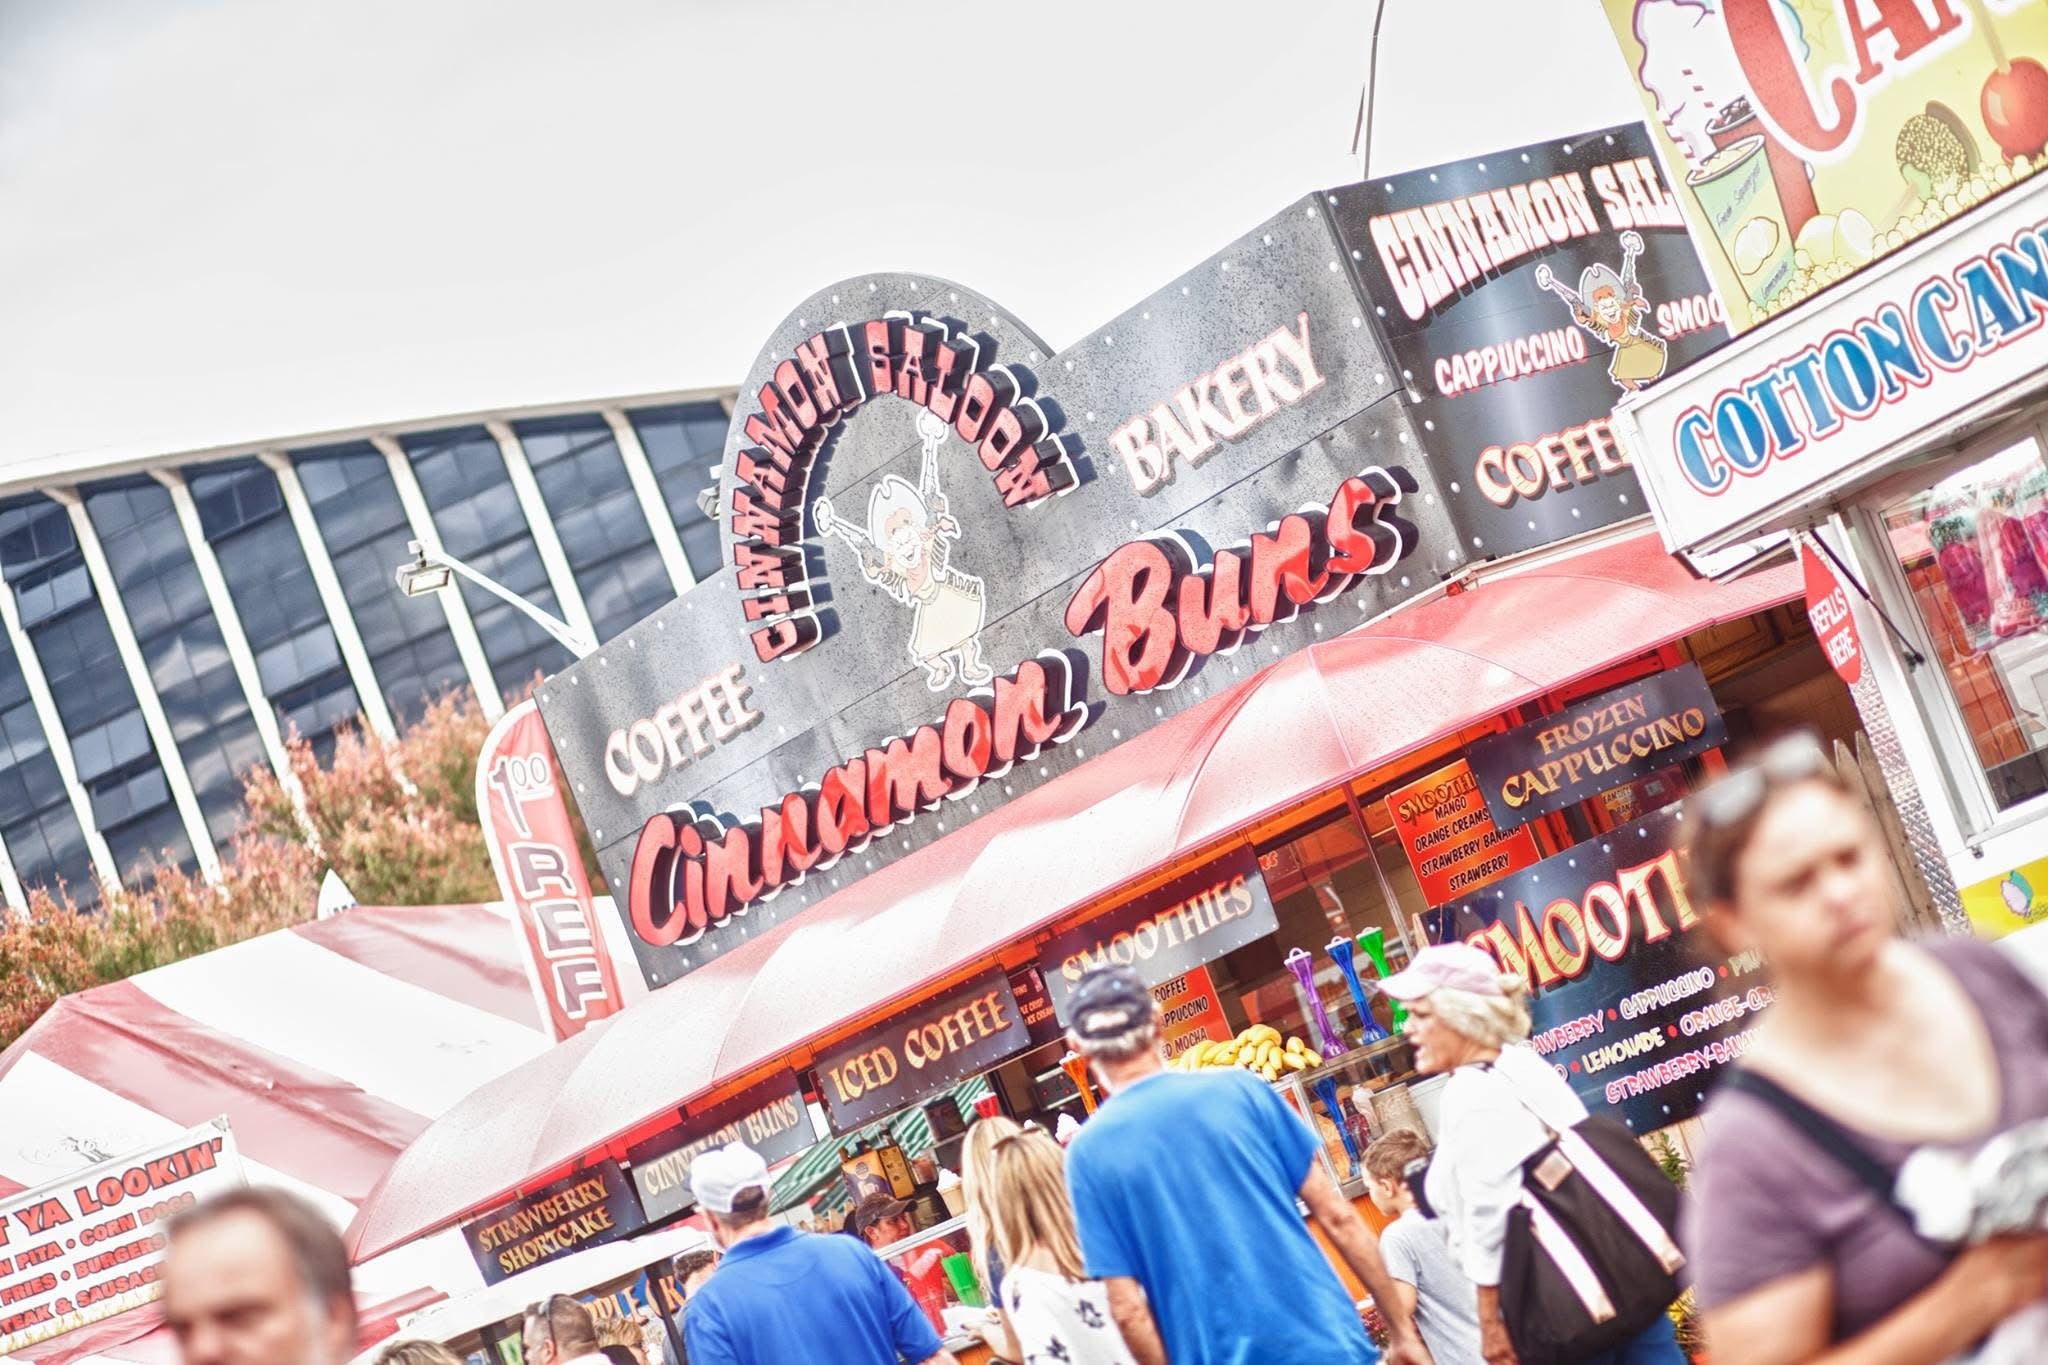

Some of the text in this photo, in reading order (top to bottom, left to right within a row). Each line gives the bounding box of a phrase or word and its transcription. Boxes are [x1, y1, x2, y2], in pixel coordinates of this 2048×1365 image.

[1722, 0, 1962, 152] CA
[1368, 171, 1602, 321] CINNAMON
[1434, 325, 1588, 397] CAPPUCCINO
[1677, 225, 2048, 492] COTTON CAN
[1106, 309, 1327, 494] BAKERY
[731, 314, 1068, 664] CINNAMON SALOON
[1808, 585, 1849, 638] REFILLS
[1825, 625, 1857, 669] HERE
[603, 663, 761, 797] COFFEE
[628, 472, 1390, 948] Cinnamon Buns
[1536, 694, 1649, 757] FROZEN
[1501, 707, 1707, 809] CAPPUCCINO
[1398, 771, 1478, 826] SMOOTH
[1434, 795, 1467, 820] MANGO
[1414, 824, 1451, 853] ORANGE
[1420, 838, 1482, 877] STRAWBERRY
[1448, 852, 1510, 891] STRAWBERRY
[1154, 976, 1188, 1002] COFFEE
[1529, 1008, 1606, 1056] AWBERRY
[1619, 965, 1716, 1021] CAPPUCCINO
[828, 990, 1013, 1103] ICED COFFEE
[1174, 1026, 1208, 1053] MOCHA
[1581, 1026, 1667, 1074] LEMONADE
[745, 1094, 800, 1145] BUNS
[13, 1197, 73, 1236] YA
[73, 1136, 223, 1216] LOOKIN'
[477, 1173, 611, 1254] STRAWBERRY
[15, 1241, 65, 1271] PITA
[79, 1213, 138, 1246] CORN
[138, 1190, 197, 1226] DOGS
[497, 1204, 617, 1276] SHORTCAKE
[1, 1231, 167, 1306] FRIES BURGERS
[0, 1303, 55, 1336] TEAK
[55, 1297, 77, 1316] &
